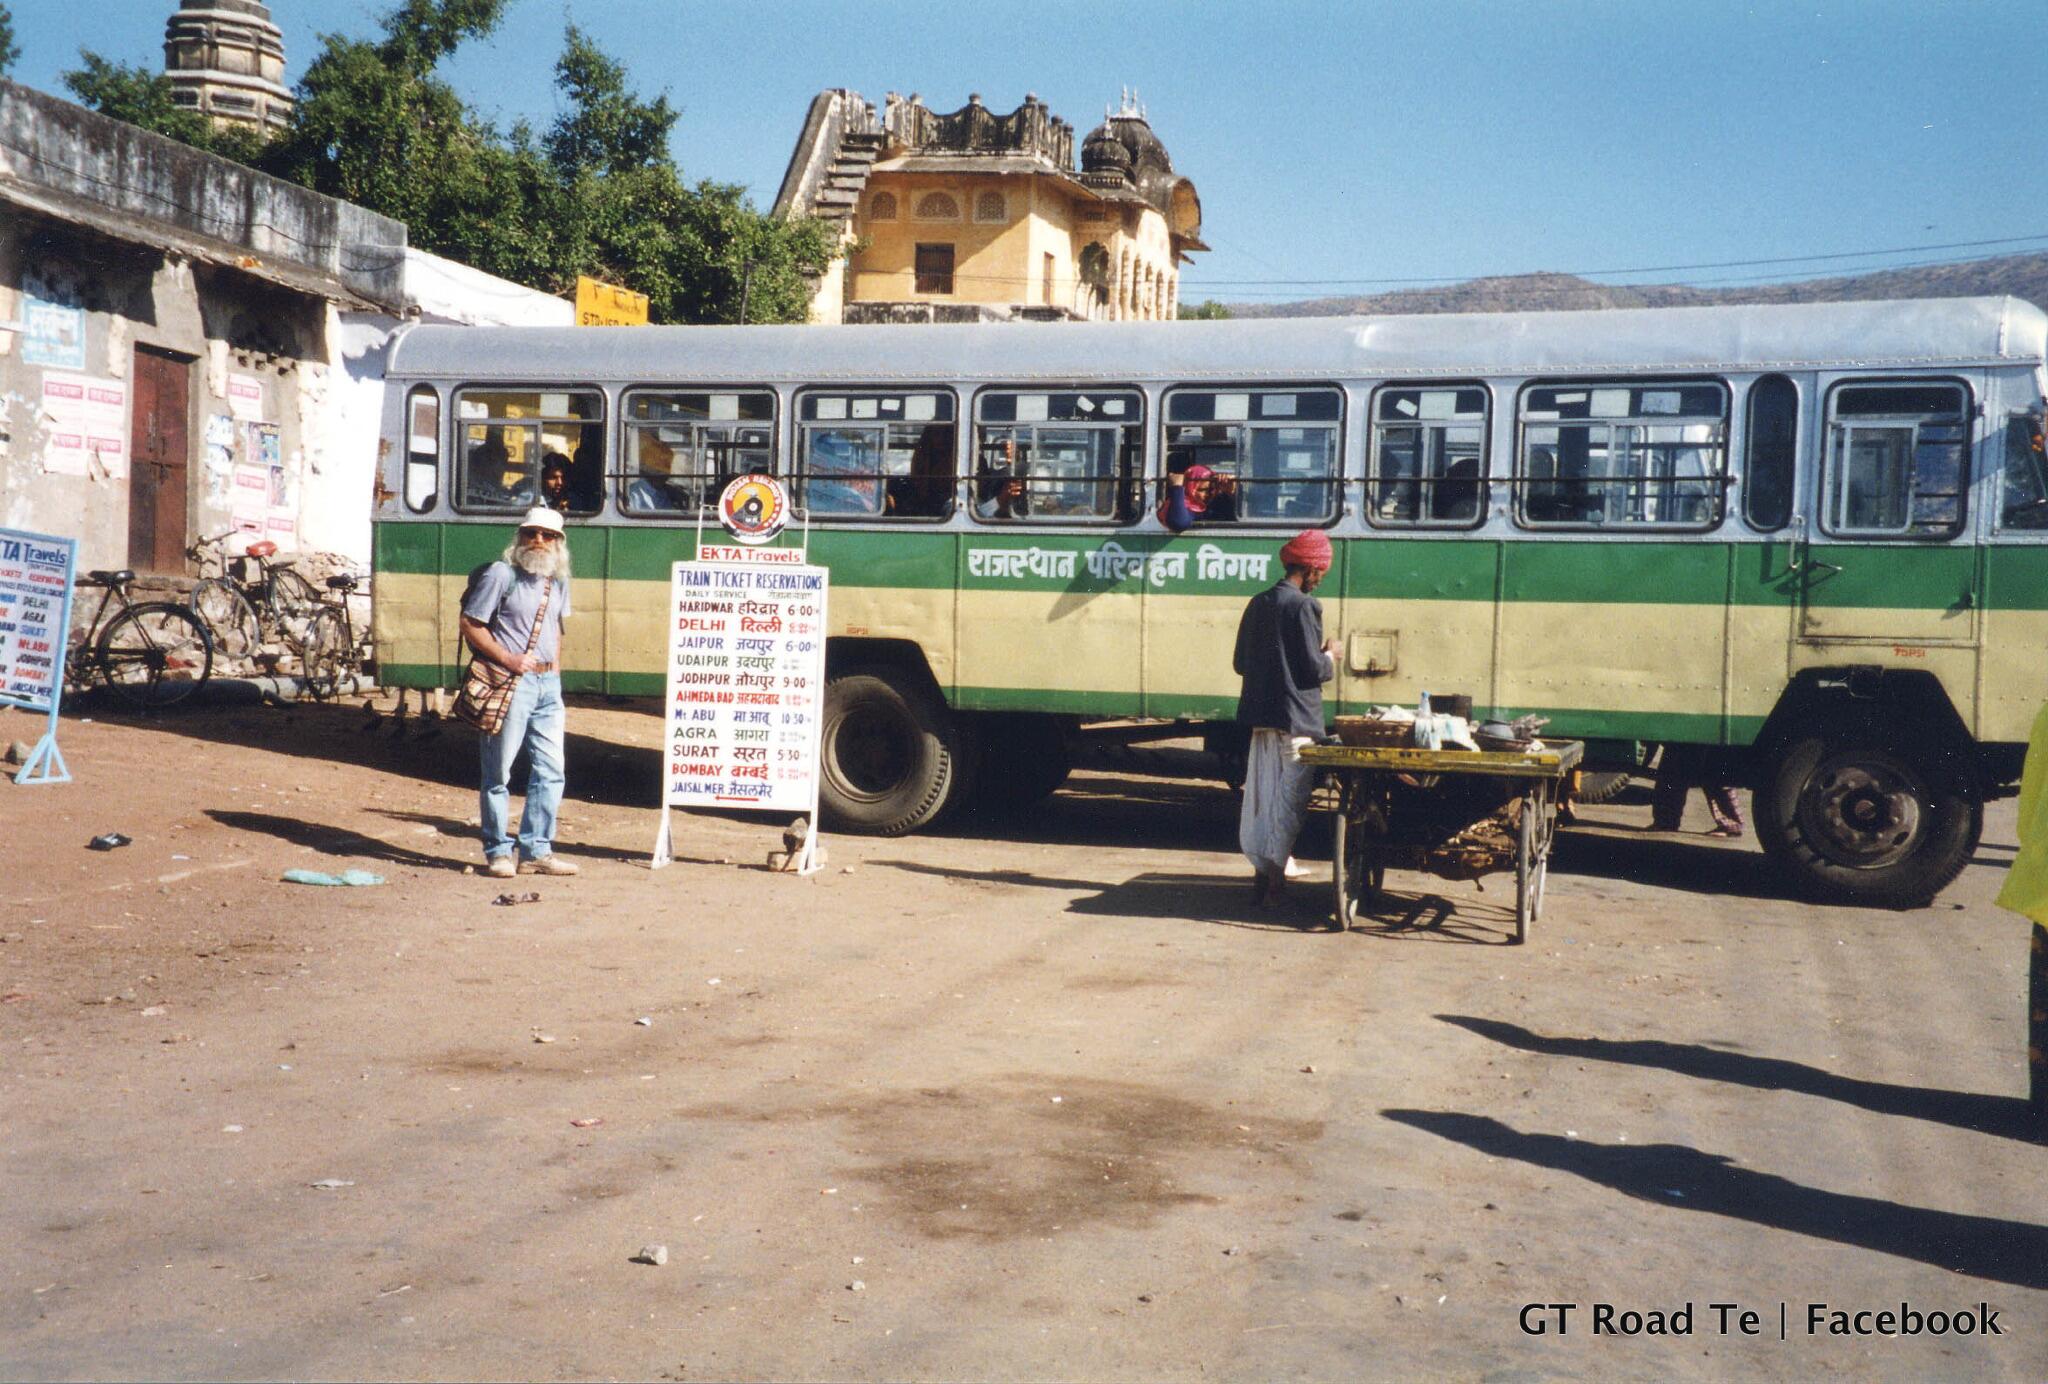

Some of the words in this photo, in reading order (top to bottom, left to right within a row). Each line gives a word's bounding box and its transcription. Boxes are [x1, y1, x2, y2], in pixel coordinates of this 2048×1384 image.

[24, 543, 66, 564] Travels
[701, 547, 741, 560] EKTA
[747, 549, 800, 562] Travels
[968, 546, 1078, 579] राजस्थान
[1084, 542, 1189, 587] परिवहन
[1196, 543, 1272, 581] निगम
[679, 571, 711, 588] TRAIN
[714, 571, 753, 588] TICKET
[756, 573, 822, 590] RESERVATIONS
[685, 590, 710, 599] DAILY
[714, 590, 747, 599] SERVICE
[679, 601, 734, 614] HARIDWAR
[22, 611, 46, 623] AGRA
[679, 619, 725, 631] DELHI
[741, 616, 783, 633] दिल्ली
[678, 637, 724, 649] JAIPUR
[736, 638, 776, 655] जयपुर
[677, 655, 729, 667] UDAIPUR
[736, 656, 775, 672] उदयपुर
[676, 673, 730, 685] JODHPUR
[735, 672, 776, 691] जोधपुर
[692, 709, 716, 721] ABU
[673, 727, 717, 739] AGRA
[734, 729, 769, 742] आगरा
[673, 745, 719, 758] SURAT
[672, 764, 724, 776] BOMBAY
[728, 780, 773, 798] जैसलमेर
